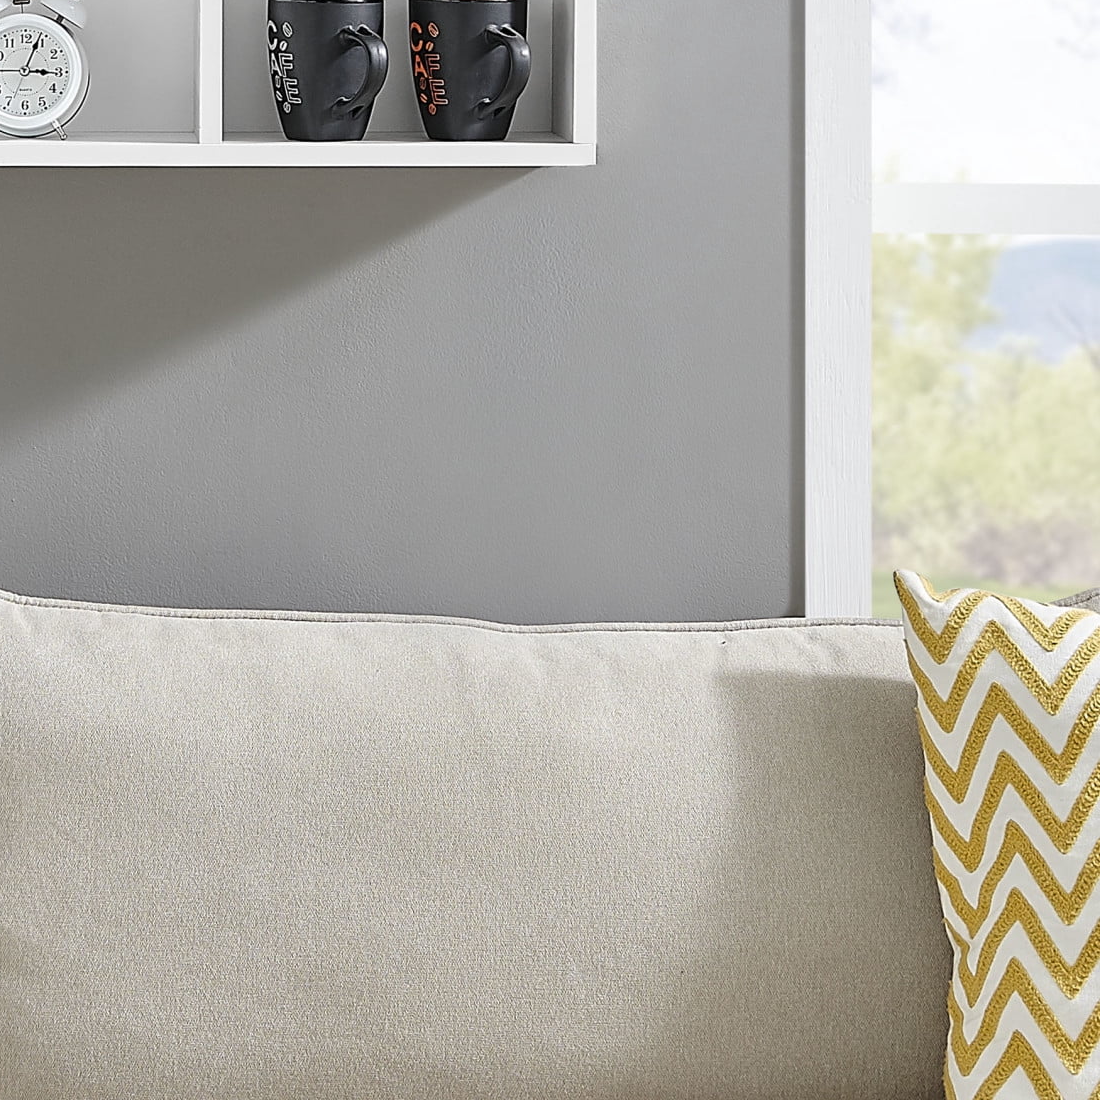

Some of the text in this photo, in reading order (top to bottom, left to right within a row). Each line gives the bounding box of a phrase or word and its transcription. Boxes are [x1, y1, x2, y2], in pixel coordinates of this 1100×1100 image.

[5, 38, 15, 48] 11
[20, 33, 32, 44] 12
[40, 38, 45, 48] 1
[50, 49, 58, 60] 2
[54, 67, 63, 77] 3
[49, 83, 58, 93] 4
[5, 96, 13, 106] 7
[21, 100, 29, 110] 6
[38, 96, 47, 107] 5
